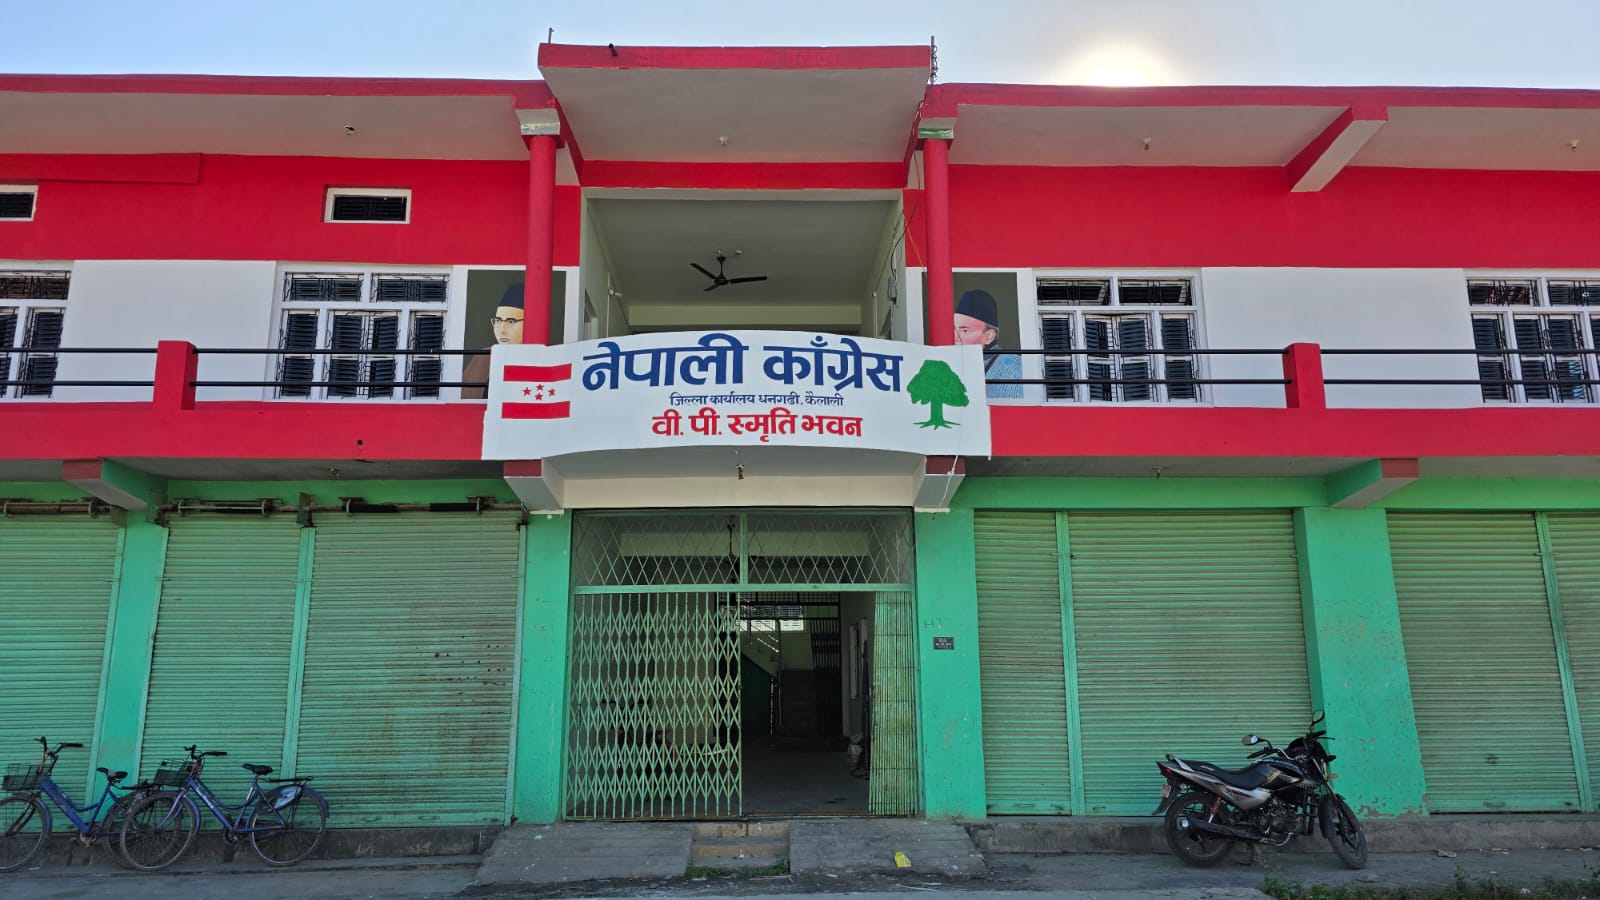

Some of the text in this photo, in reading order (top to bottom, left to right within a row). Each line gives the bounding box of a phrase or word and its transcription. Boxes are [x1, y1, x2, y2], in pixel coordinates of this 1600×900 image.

[582, 333, 903, 392] नेपाली काँग्रेस
[669, 391, 709, 406] जिल्ला
[710, 390, 756, 405] कार्यालय
[805, 391, 844, 406] कैलाली
[688, 407, 722, 436] पी.
[727, 407, 797, 442] स्मृति
[801, 415, 863, 436] भवन
